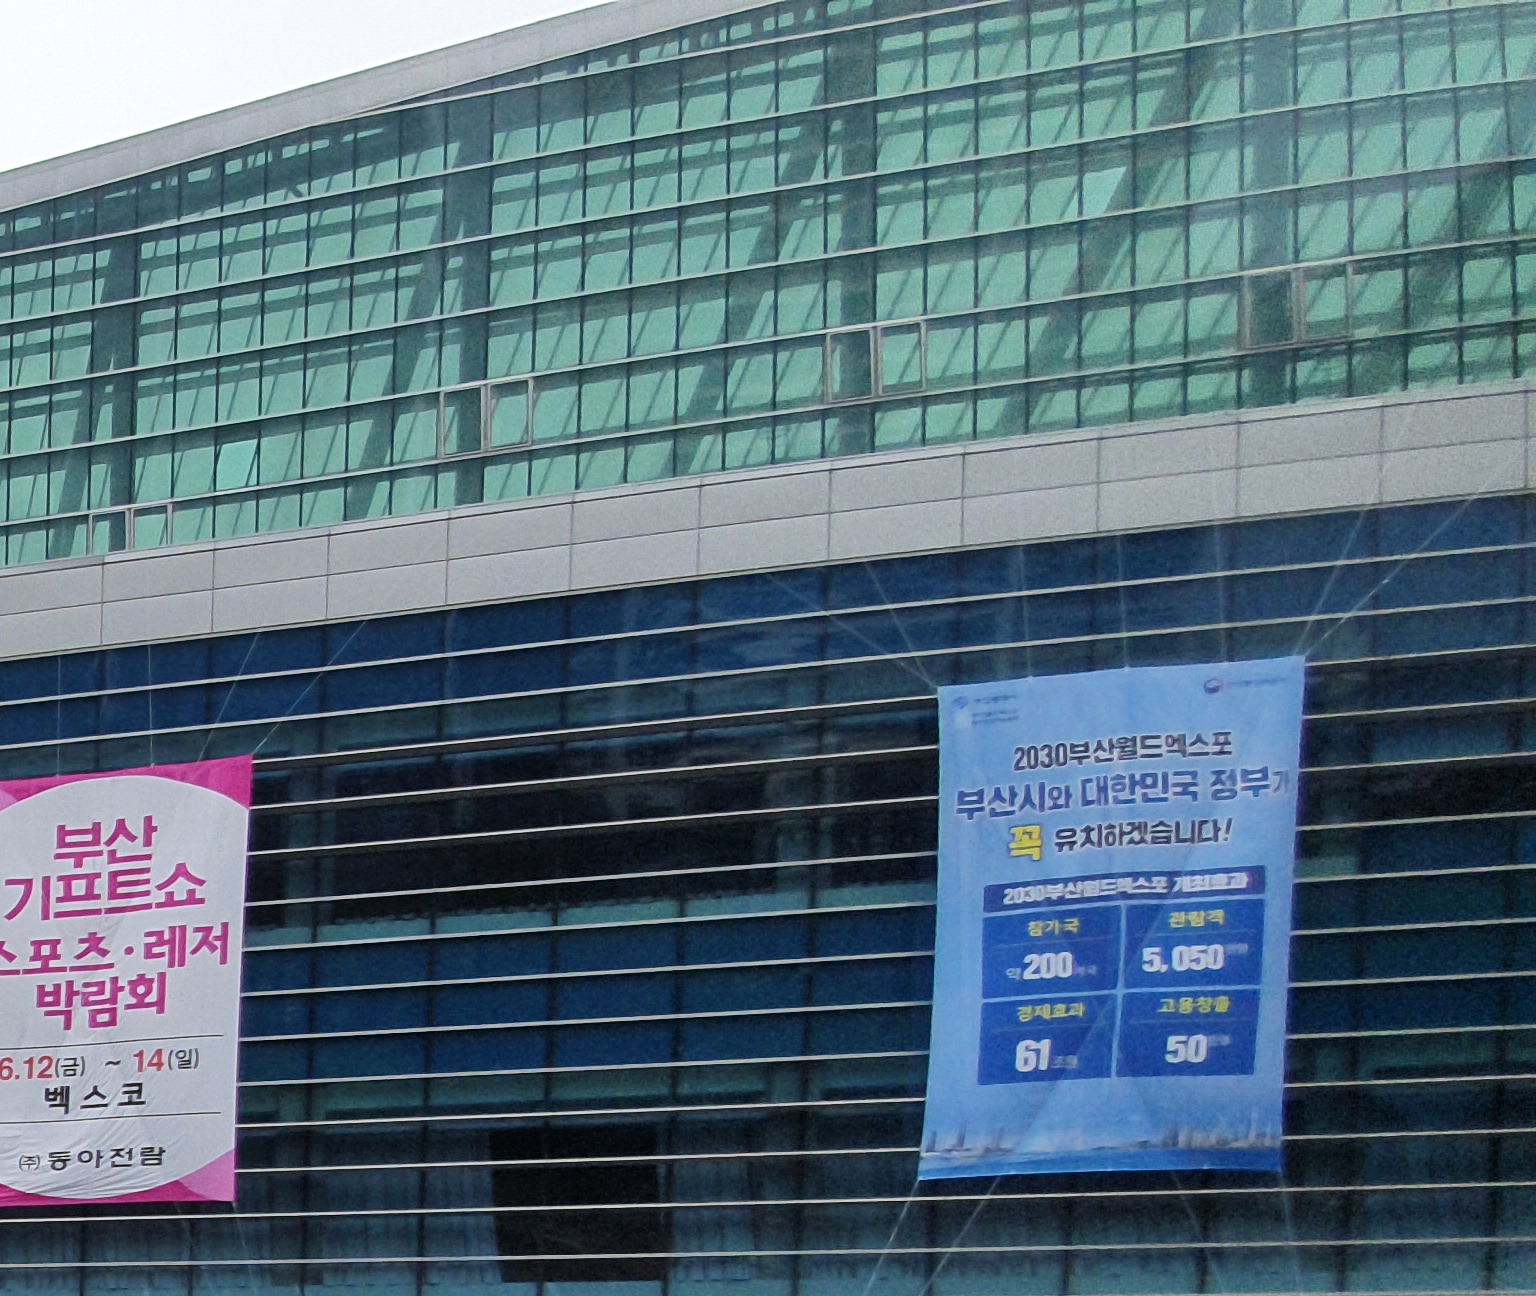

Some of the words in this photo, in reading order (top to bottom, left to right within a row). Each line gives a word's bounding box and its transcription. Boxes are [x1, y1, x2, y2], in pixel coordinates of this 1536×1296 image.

[1013, 731, 1233, 771] 2030부산월드엑스포
[956, 781, 1072, 820] 부산시와
[1080, 769, 1199, 806] 대한민국
[1209, 765, 1291, 801] 정부가
[53, 815, 158, 869] 부산
[1007, 824, 1044, 861] 꼭
[1053, 817, 1233, 853] 유치하겠습니다!
[3, 862, 207, 922] 기프트쇼
[1028, 917, 1080, 937] 참가국
[35, 971, 166, 1031] 박람회
[133, 1047, 200, 1073] 14(일)
